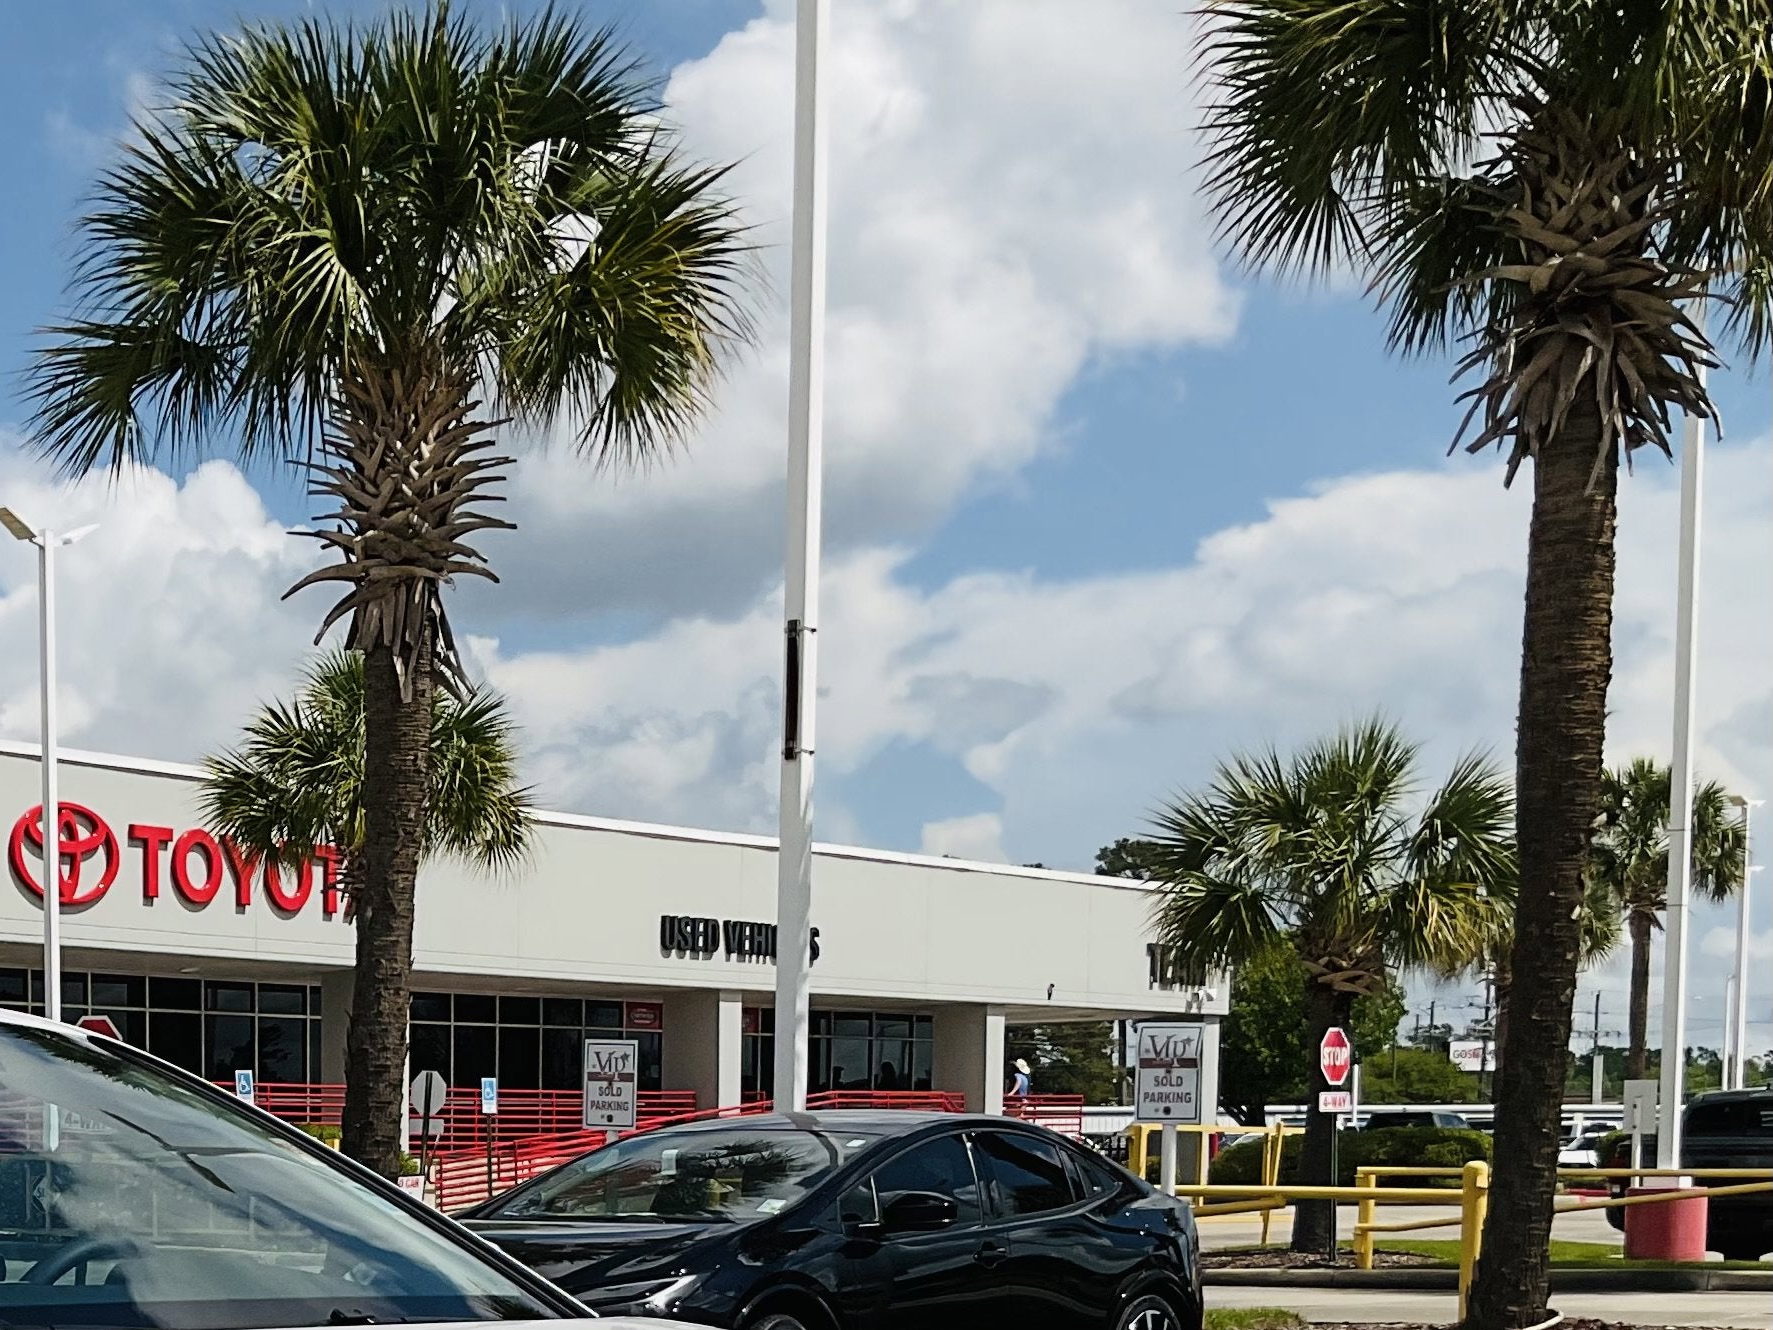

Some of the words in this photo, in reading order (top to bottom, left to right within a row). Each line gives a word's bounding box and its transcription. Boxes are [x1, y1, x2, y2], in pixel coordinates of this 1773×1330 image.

[128, 824, 352, 915] TOYOT
[660, 915, 720, 953] USED
[723, 920, 820, 961] VEHIS
[1323, 1046, 1348, 1066] STOP
[1154, 1075, 1183, 1087] SOLD
[598, 1086, 622, 1097] SOLD
[1143, 1092, 1192, 1103] PARKING
[590, 1100, 629, 1111] PARKING
[1323, 1096, 1347, 1108] 4-WAY
